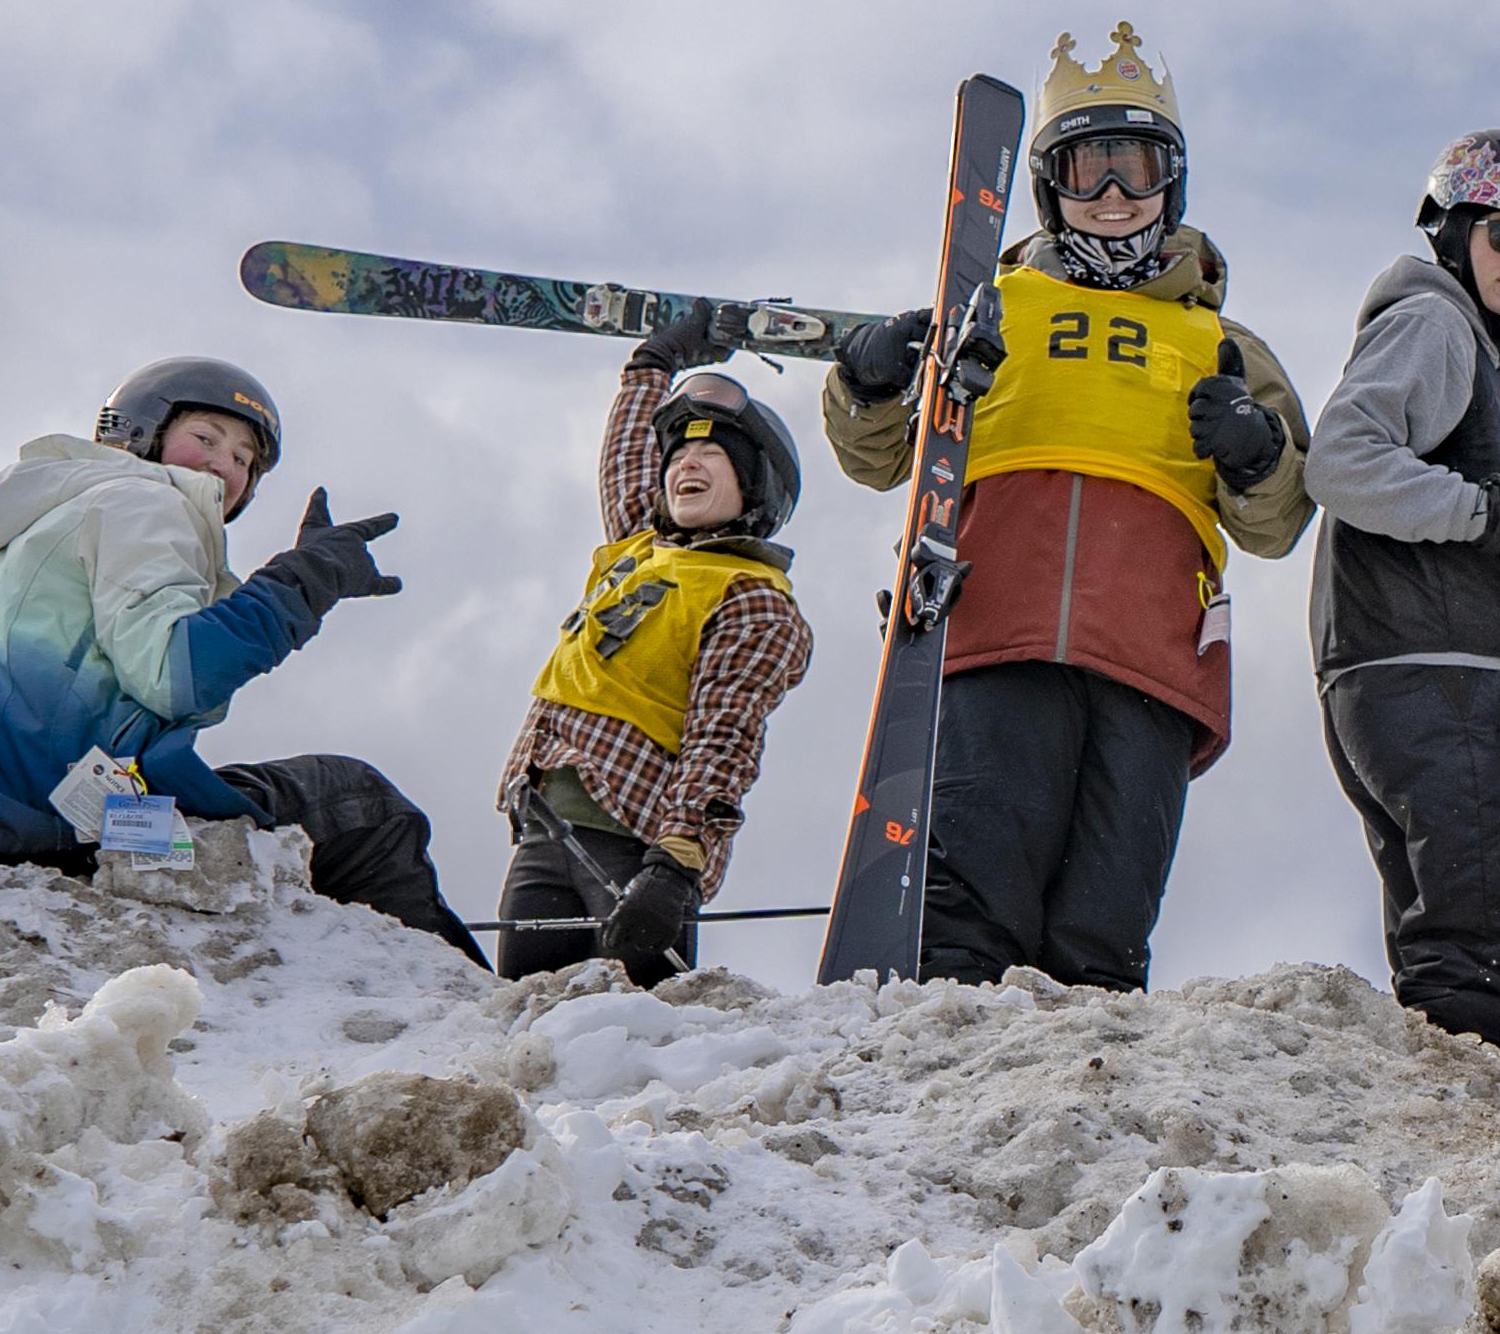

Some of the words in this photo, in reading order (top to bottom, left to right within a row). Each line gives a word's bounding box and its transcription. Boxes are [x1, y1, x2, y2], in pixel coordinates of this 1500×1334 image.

[1060, 115, 1090, 132] SMITH
[979, 188, 1005, 214] 76
[1048, 311, 1148, 368] 22
[885, 821, 915, 845] 76
